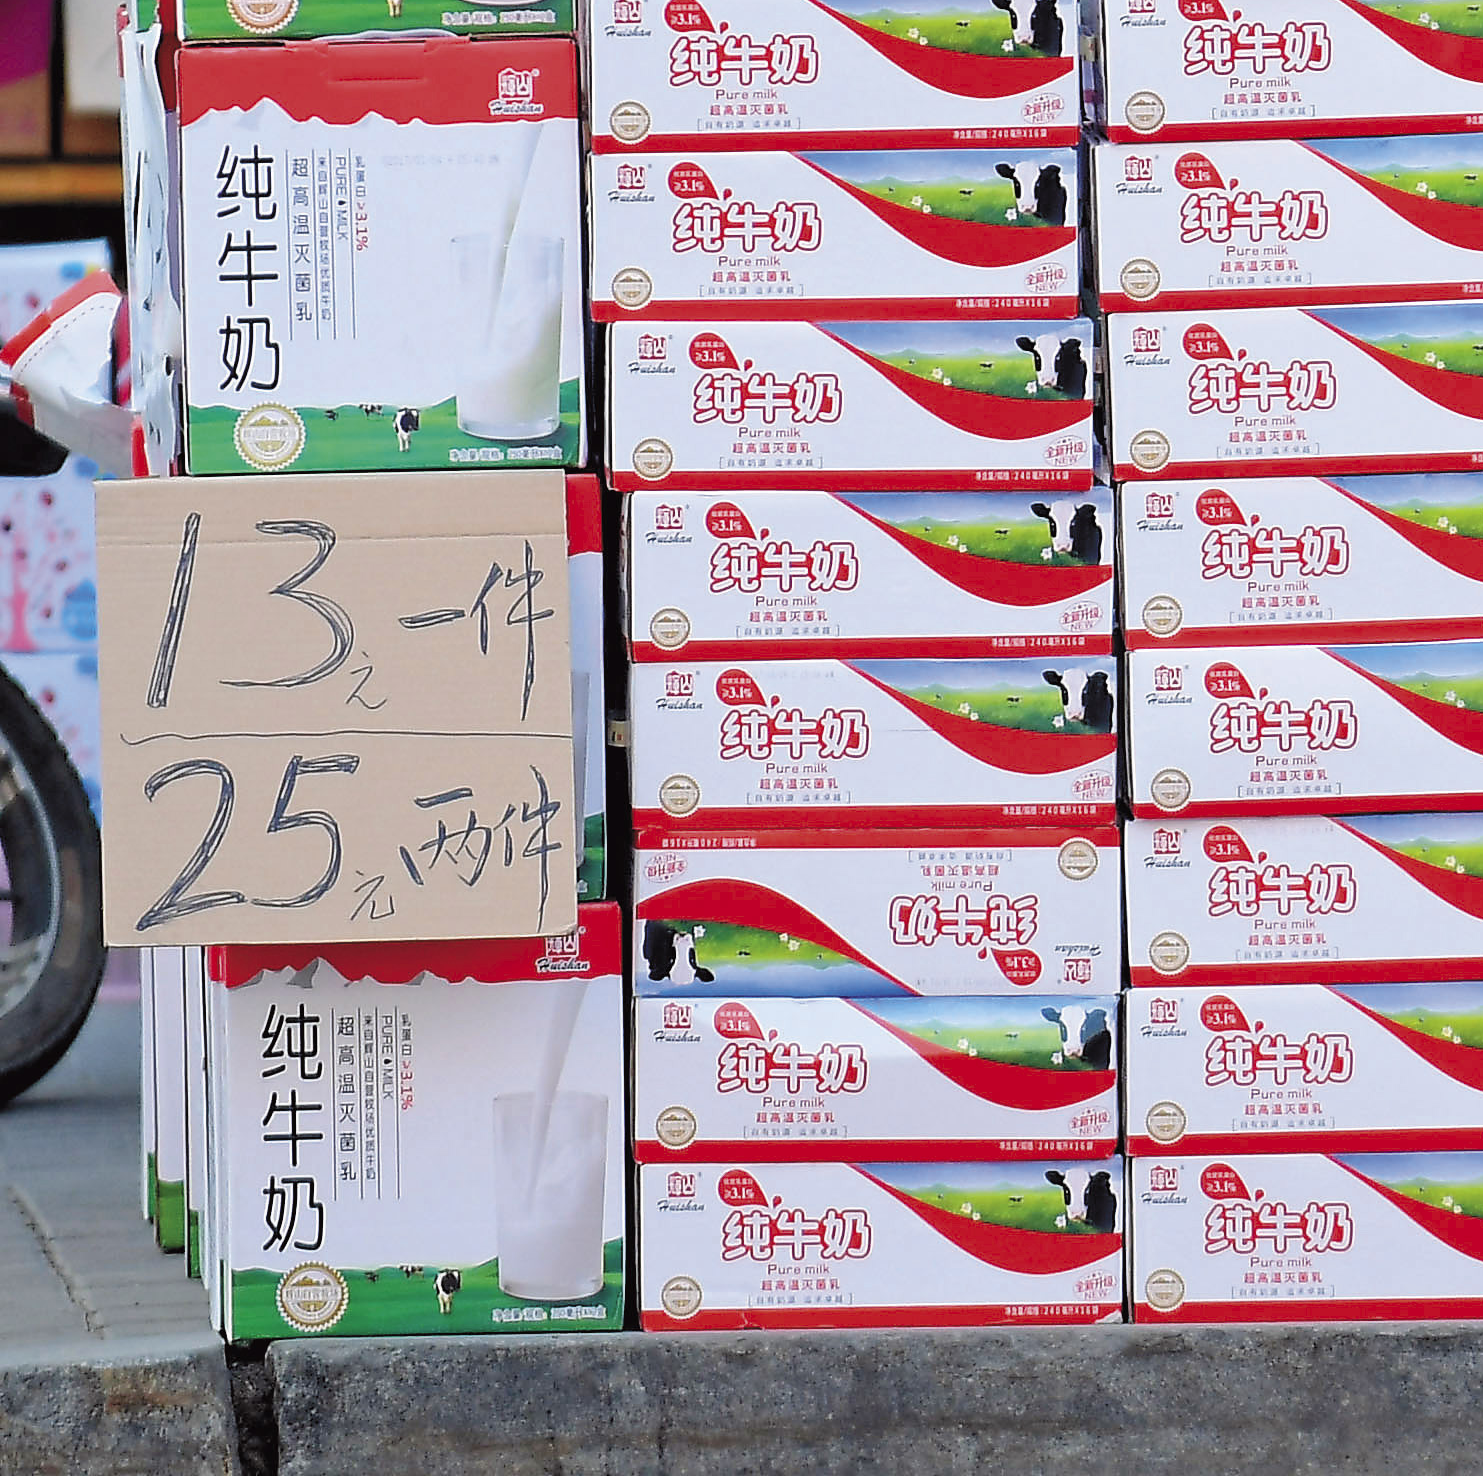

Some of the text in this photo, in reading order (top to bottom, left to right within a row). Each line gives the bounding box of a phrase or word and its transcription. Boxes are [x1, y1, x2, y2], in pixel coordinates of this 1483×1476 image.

[670, 35, 820, 86] 纯牛奶
[1183, 23, 1333, 74] 纯牛奶
[336, 157, 348, 240] PURE MILK
[1180, 191, 1330, 242] 纯牛奶
[291, 158, 312, 321] 超高温灭菌乳
[673, 202, 823, 253] 纯牛奶
[216, 144, 280, 392] 纯牛奶
[1123, 355, 1170, 367] Huishan
[694, 373, 844, 424] 纯牛奶
[1188, 362, 1338, 413] 纯牛奶
[1229, 430, 1308, 442] 超高温灭菌乳
[1234, 415, 1297, 428] Pure milk
[710, 542, 860, 593] 纯牛奶
[1201, 527, 1351, 578] 纯牛奶
[655, 699, 702, 711] Huishan
[1210, 701, 1360, 752] 纯牛奶
[721, 709, 871, 760] 纯牛奶
[760, 778, 839, 790] 超高温灭菌乳
[765, 763, 828, 775] Pure milk
[1208, 865, 1358, 916] 纯牛奶
[887, 895, 1037, 946] 纯牛奶
[382, 1016, 393, 1099] PURE MILK
[718, 1043, 868, 1094] 纯牛奶
[1205, 1034, 1355, 1085] 纯牛奶
[338, 1017, 356, 1181] 超高温灭菌乳
[262, 1003, 325, 1252] 纯牛奶
[723, 1210, 873, 1261] 纯牛奶
[1205, 1203, 1355, 1254] 纯牛奶
